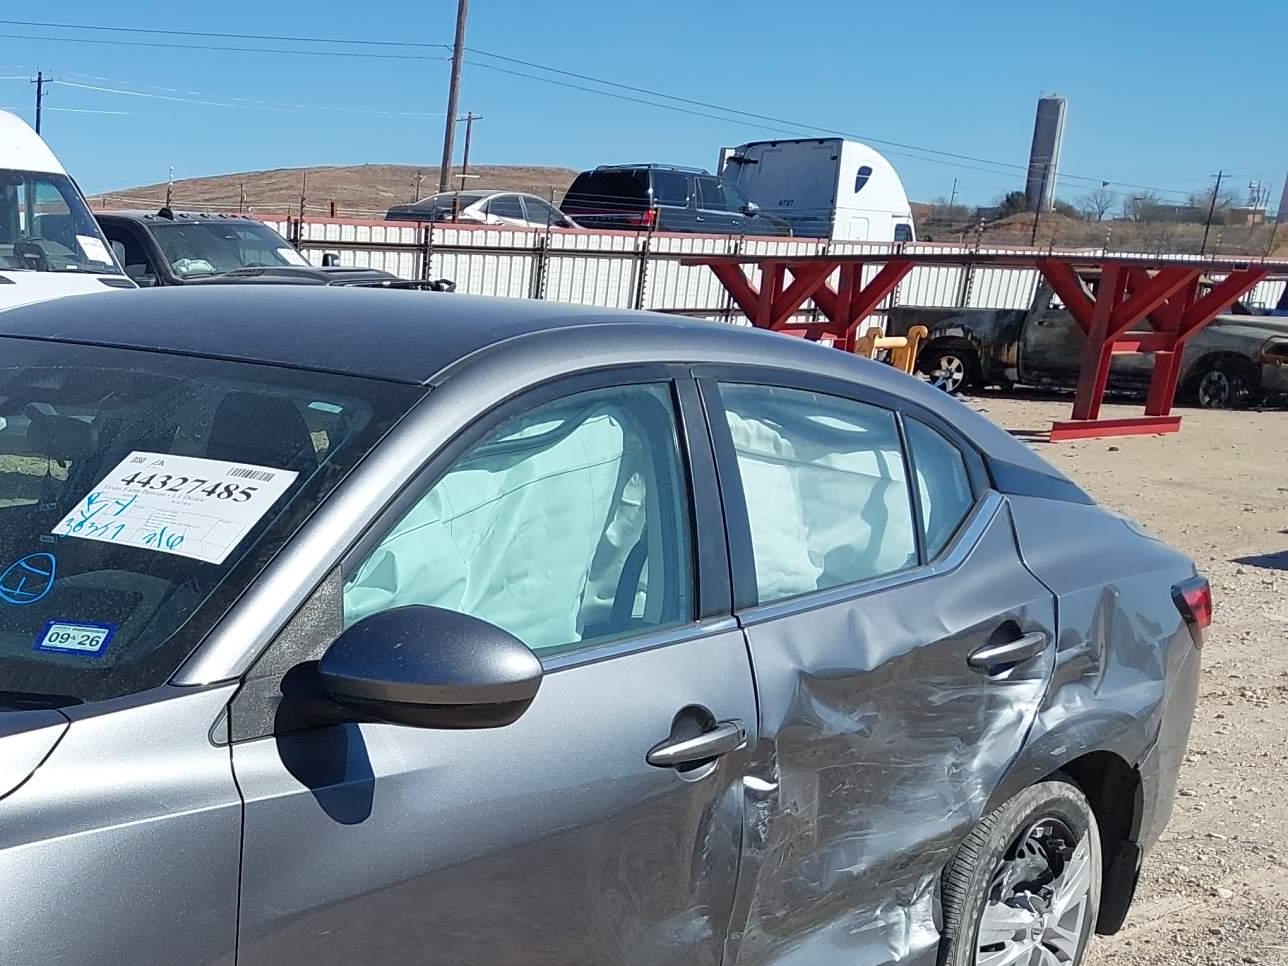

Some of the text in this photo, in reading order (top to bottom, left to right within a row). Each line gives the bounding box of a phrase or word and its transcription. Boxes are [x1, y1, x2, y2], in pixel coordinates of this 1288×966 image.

[121, 471, 258, 502] 44327485
[48, 631, 102, 647] 09 26
